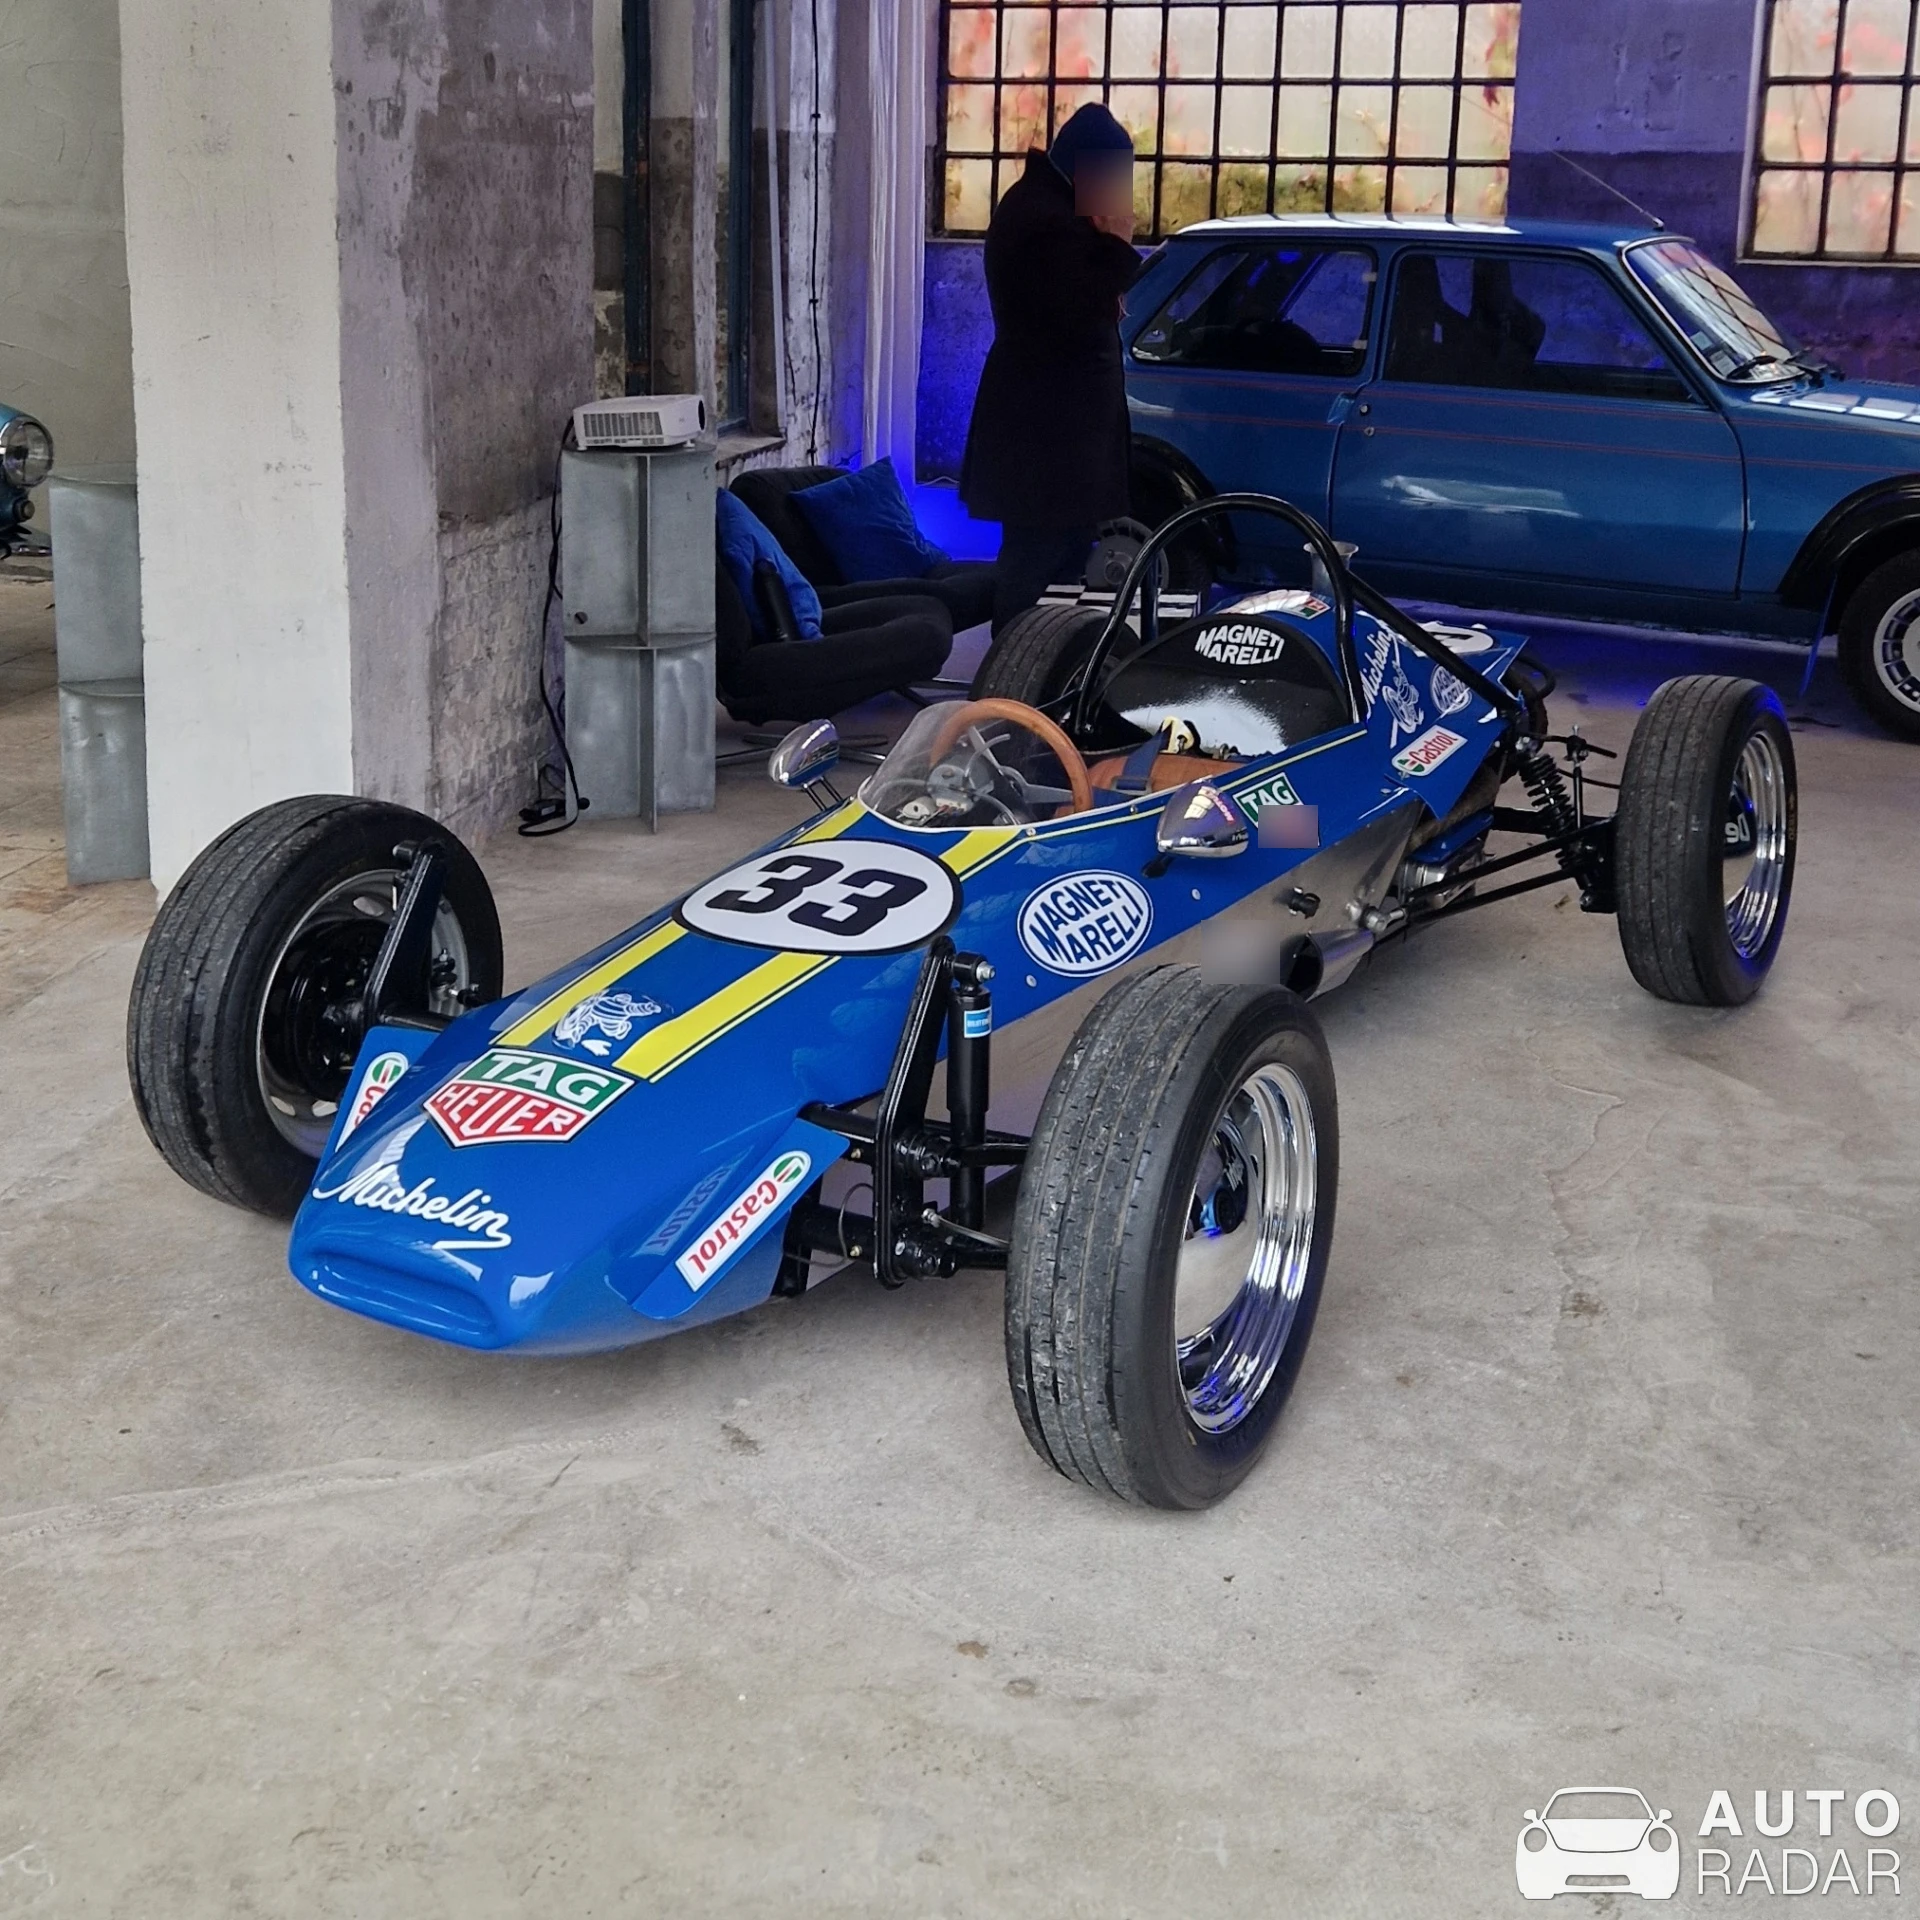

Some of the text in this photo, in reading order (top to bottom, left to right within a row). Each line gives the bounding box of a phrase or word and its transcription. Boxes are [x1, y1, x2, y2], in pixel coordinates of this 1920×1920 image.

[1195, 624, 1285, 650] MAGNETI
[1195, 641, 1285, 665] MARELLI
[1409, 730, 1458, 765] Castrol
[705, 855, 928, 936] 33
[1029, 880, 1143, 941] MAGNETI
[1033, 905, 1143, 963] MARELLI
[482, 1053, 609, 1105] TAG
[436, 1085, 572, 1138] HEUER
[312, 1160, 512, 1250] Michelin
[687, 1180, 778, 1273] Castrol
